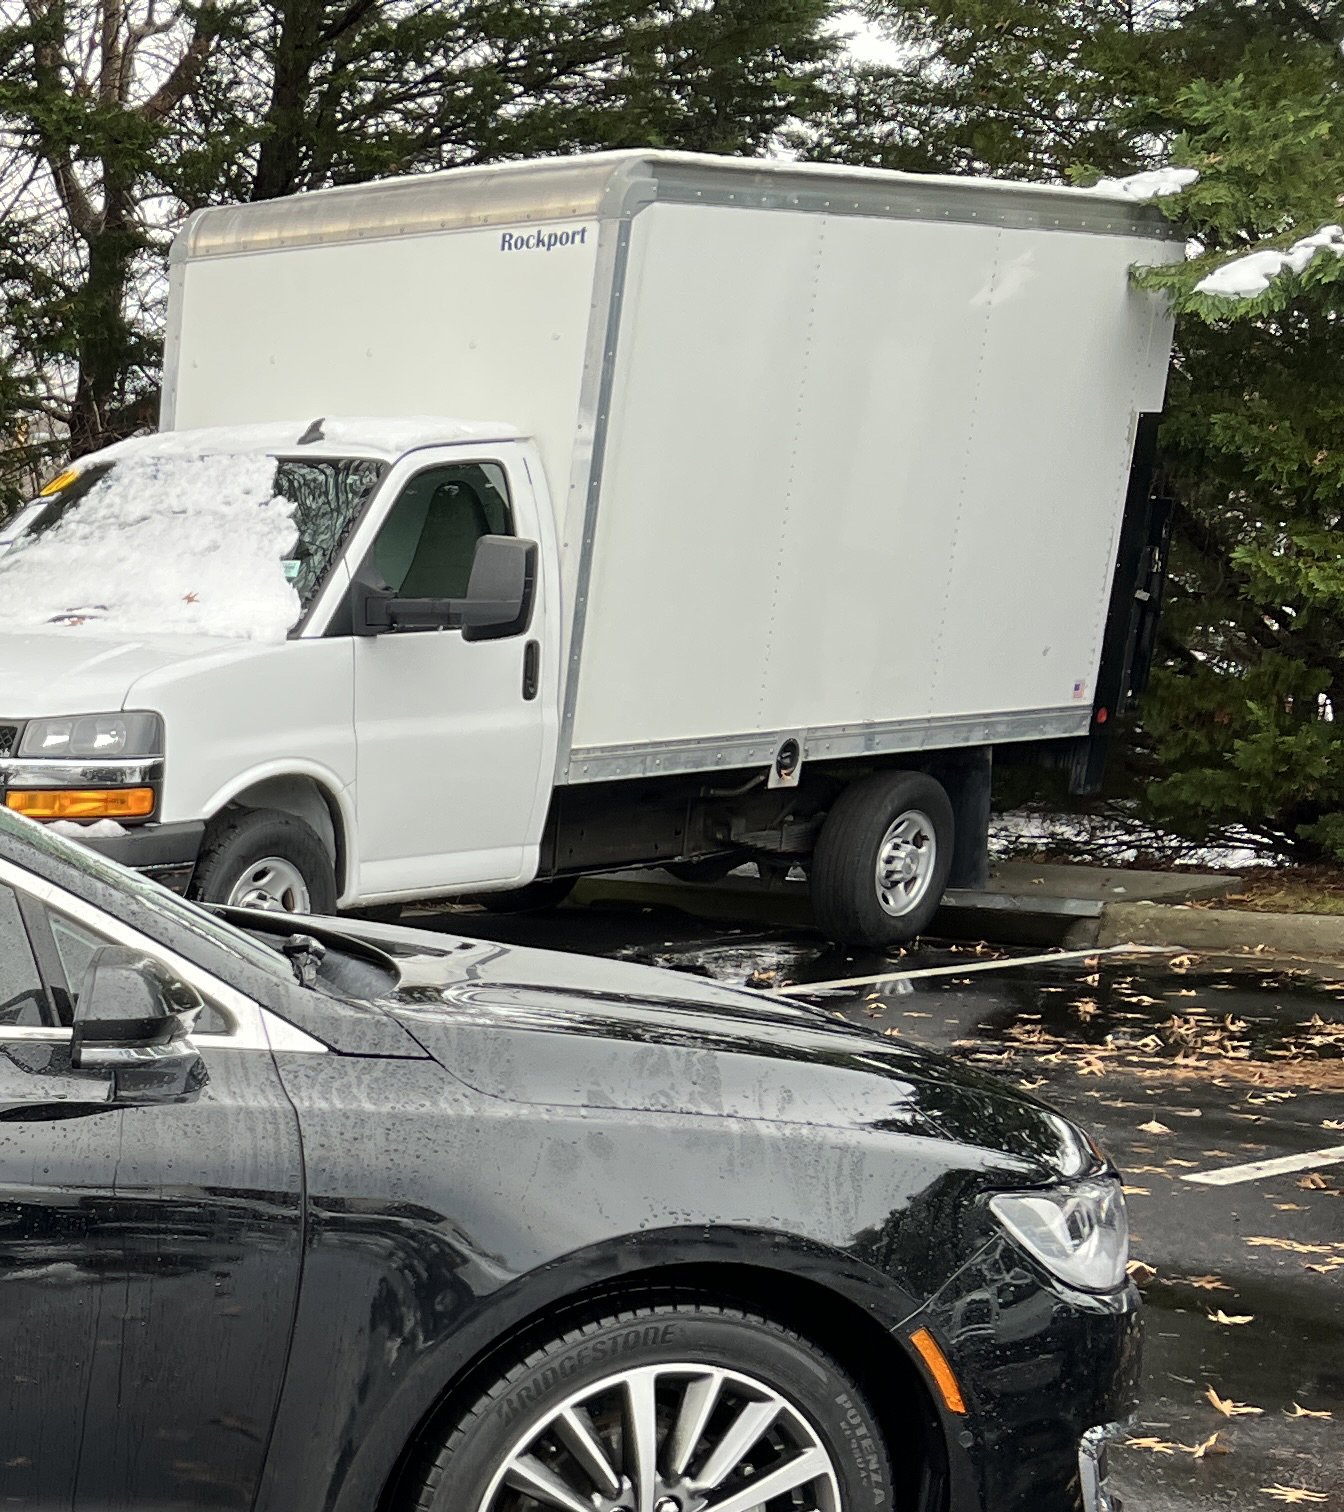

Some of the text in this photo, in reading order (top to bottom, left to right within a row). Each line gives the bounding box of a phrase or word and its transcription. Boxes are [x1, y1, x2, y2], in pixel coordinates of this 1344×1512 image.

[500, 226, 587, 251] Rockport
[496, 1322, 677, 1427] BRIDGESTONE
[835, 1393, 885, 1505] POTENZA
